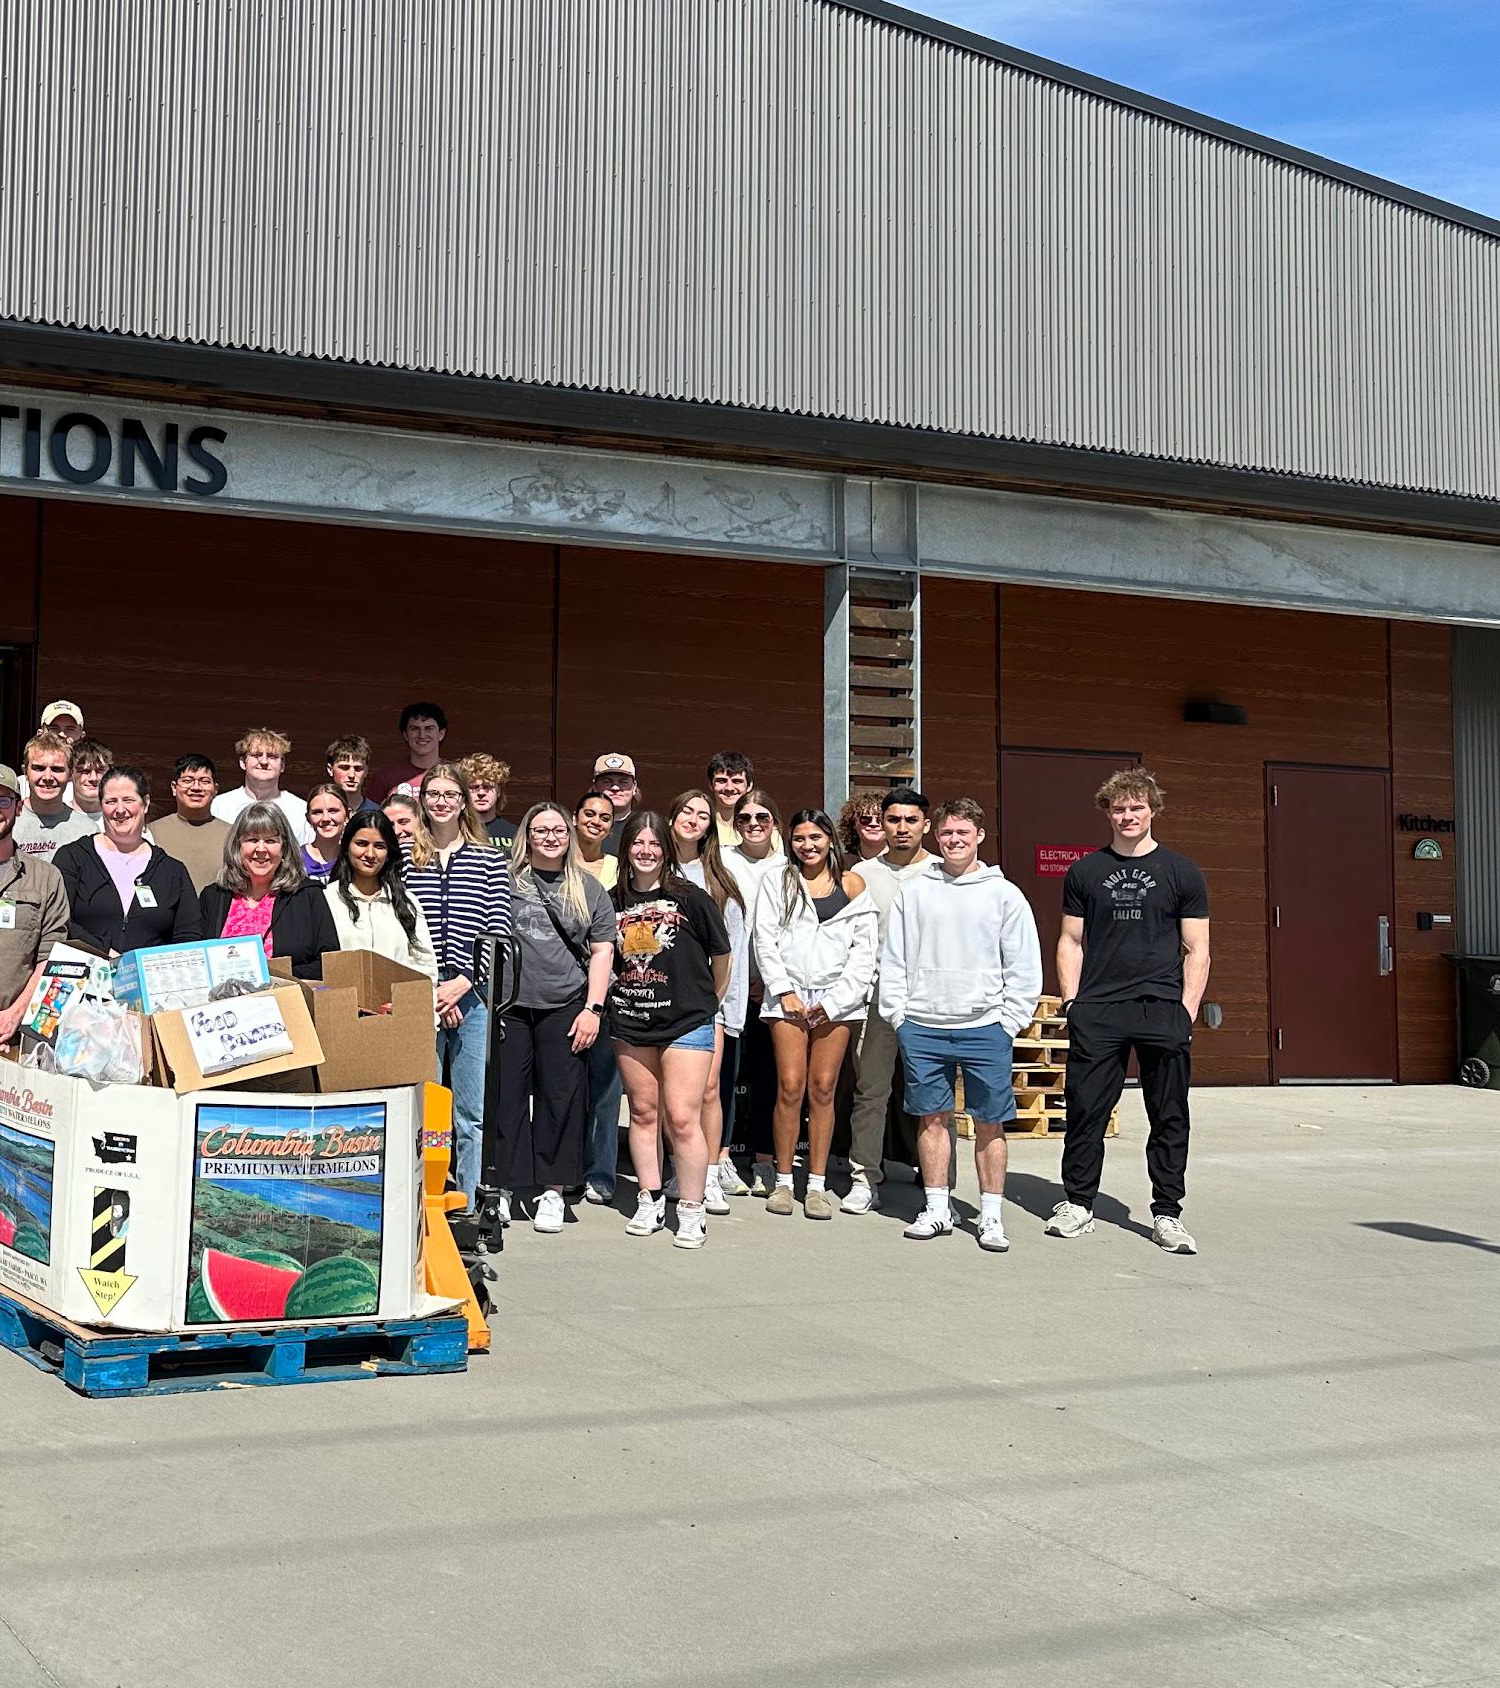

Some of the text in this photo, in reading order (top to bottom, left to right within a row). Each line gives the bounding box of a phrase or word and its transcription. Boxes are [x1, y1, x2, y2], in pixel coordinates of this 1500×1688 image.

[1400, 814, 1455, 833] Kitchen
[1040, 849, 1081, 861] ELECTRICAL
[201, 1124, 381, 1158] Columbia Basin
[85, 1166, 114, 1176] PRODUCE
[204, 1158, 377, 1176] PREMIUM WATERMELONS
[94, 1277, 120, 1289] Watch
[95, 1289, 117, 1302] Step!
